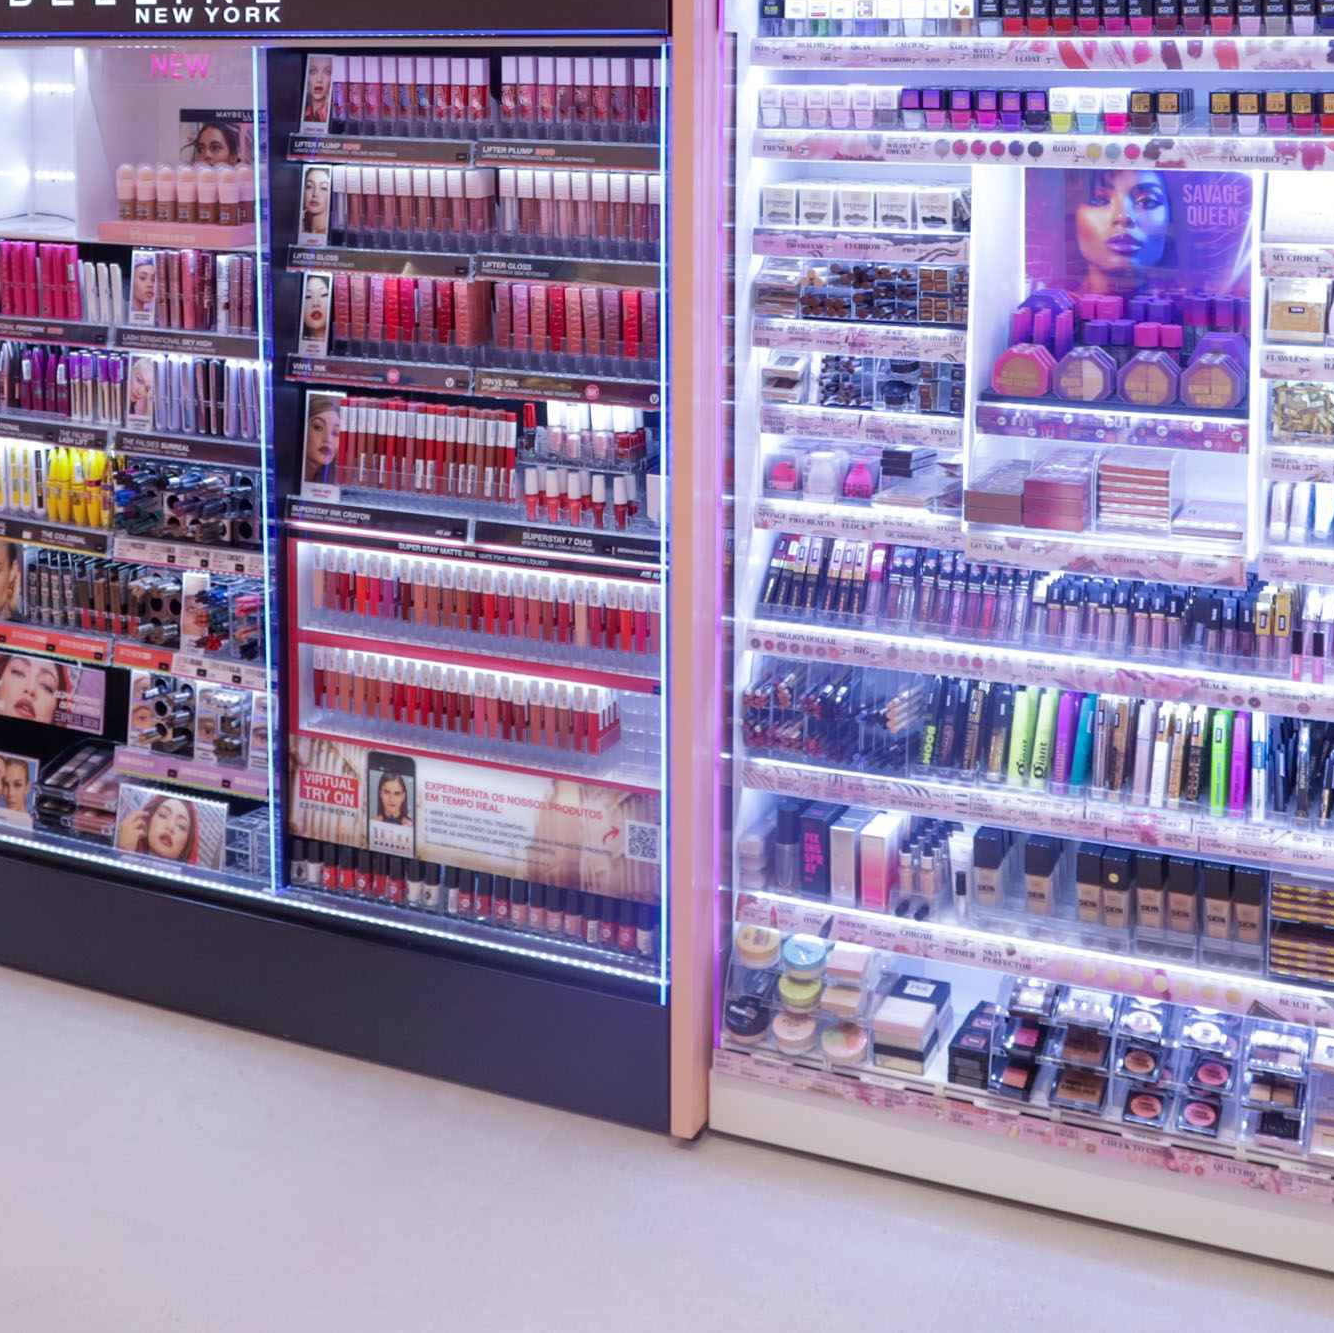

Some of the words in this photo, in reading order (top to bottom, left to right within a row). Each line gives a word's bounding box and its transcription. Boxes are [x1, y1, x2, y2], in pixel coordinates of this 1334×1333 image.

[135, 7, 194, 24] NEW
[204, 6, 281, 23] YORK
[150, 53, 211, 79] NEW
[294, 141, 316, 150] LIFTER
[317, 142, 341, 151] PLUMP
[483, 146, 507, 155] LIFTER
[508, 147, 533, 156] PLUMP
[1228, 155, 1281, 164] INCREDIBLE
[1182, 184, 1242, 204] SAVAGE
[1186, 206, 1239, 226] QUEEN
[292, 252, 316, 261] LIFTER
[317, 253, 339, 262] GLOSS
[1287, 254, 1321, 263] CHOICE
[482, 261, 508, 270] LIFTER
[509, 262, 532, 271] GLOSS
[482, 378, 503, 386] VINYL
[505, 379, 519, 387] INK
[291, 504, 327, 515] SUPERSTAY
[329, 509, 341, 517] INK
[342, 510, 370, 521] CRAYON
[54, 533, 86, 544] COLOSSAL
[522, 531, 564, 544] SUPERSTAY
[566, 536, 572, 544] 7
[573, 537, 593, 547] DIAS
[398, 542, 420, 552] SUPER
[421, 544, 439, 554] STAY
[440, 546, 463, 556] MATTE
[464, 548, 477, 558] INK
[303, 772, 355, 792] VIRTUAL
[303, 786, 330, 803] TRY
[333, 792, 355, 806] ON
[425, 781, 489, 801] EXPERIMENTA
[491, 792, 505, 802] OS
[507, 795, 547, 810] NOSSOS
[548, 802, 603, 820] PRODUTOS
[425, 793, 439, 803] EM
[440, 795, 474, 809] TEMPO
[804, 833, 820, 844] FIX
[804, 843, 822, 854] ING
[804, 853, 824, 865] SPR
[804, 863, 817, 874] AY
[978, 884, 995, 892] SKIN
[1028, 891, 1045, 900] SKIN
[1079, 899, 1098, 909] SKIN
[1105, 904, 1123, 915] SKIN
[1207, 912, 1227, 924] SKIN
[900, 929, 933, 941] CHROME
[945, 947, 976, 959] PRIMER
[982, 955, 1031, 971] PERFECTOR
[1278, 997, 1310, 1010] BEACH
[1213, 1162, 1257, 1177] QUATTRO
